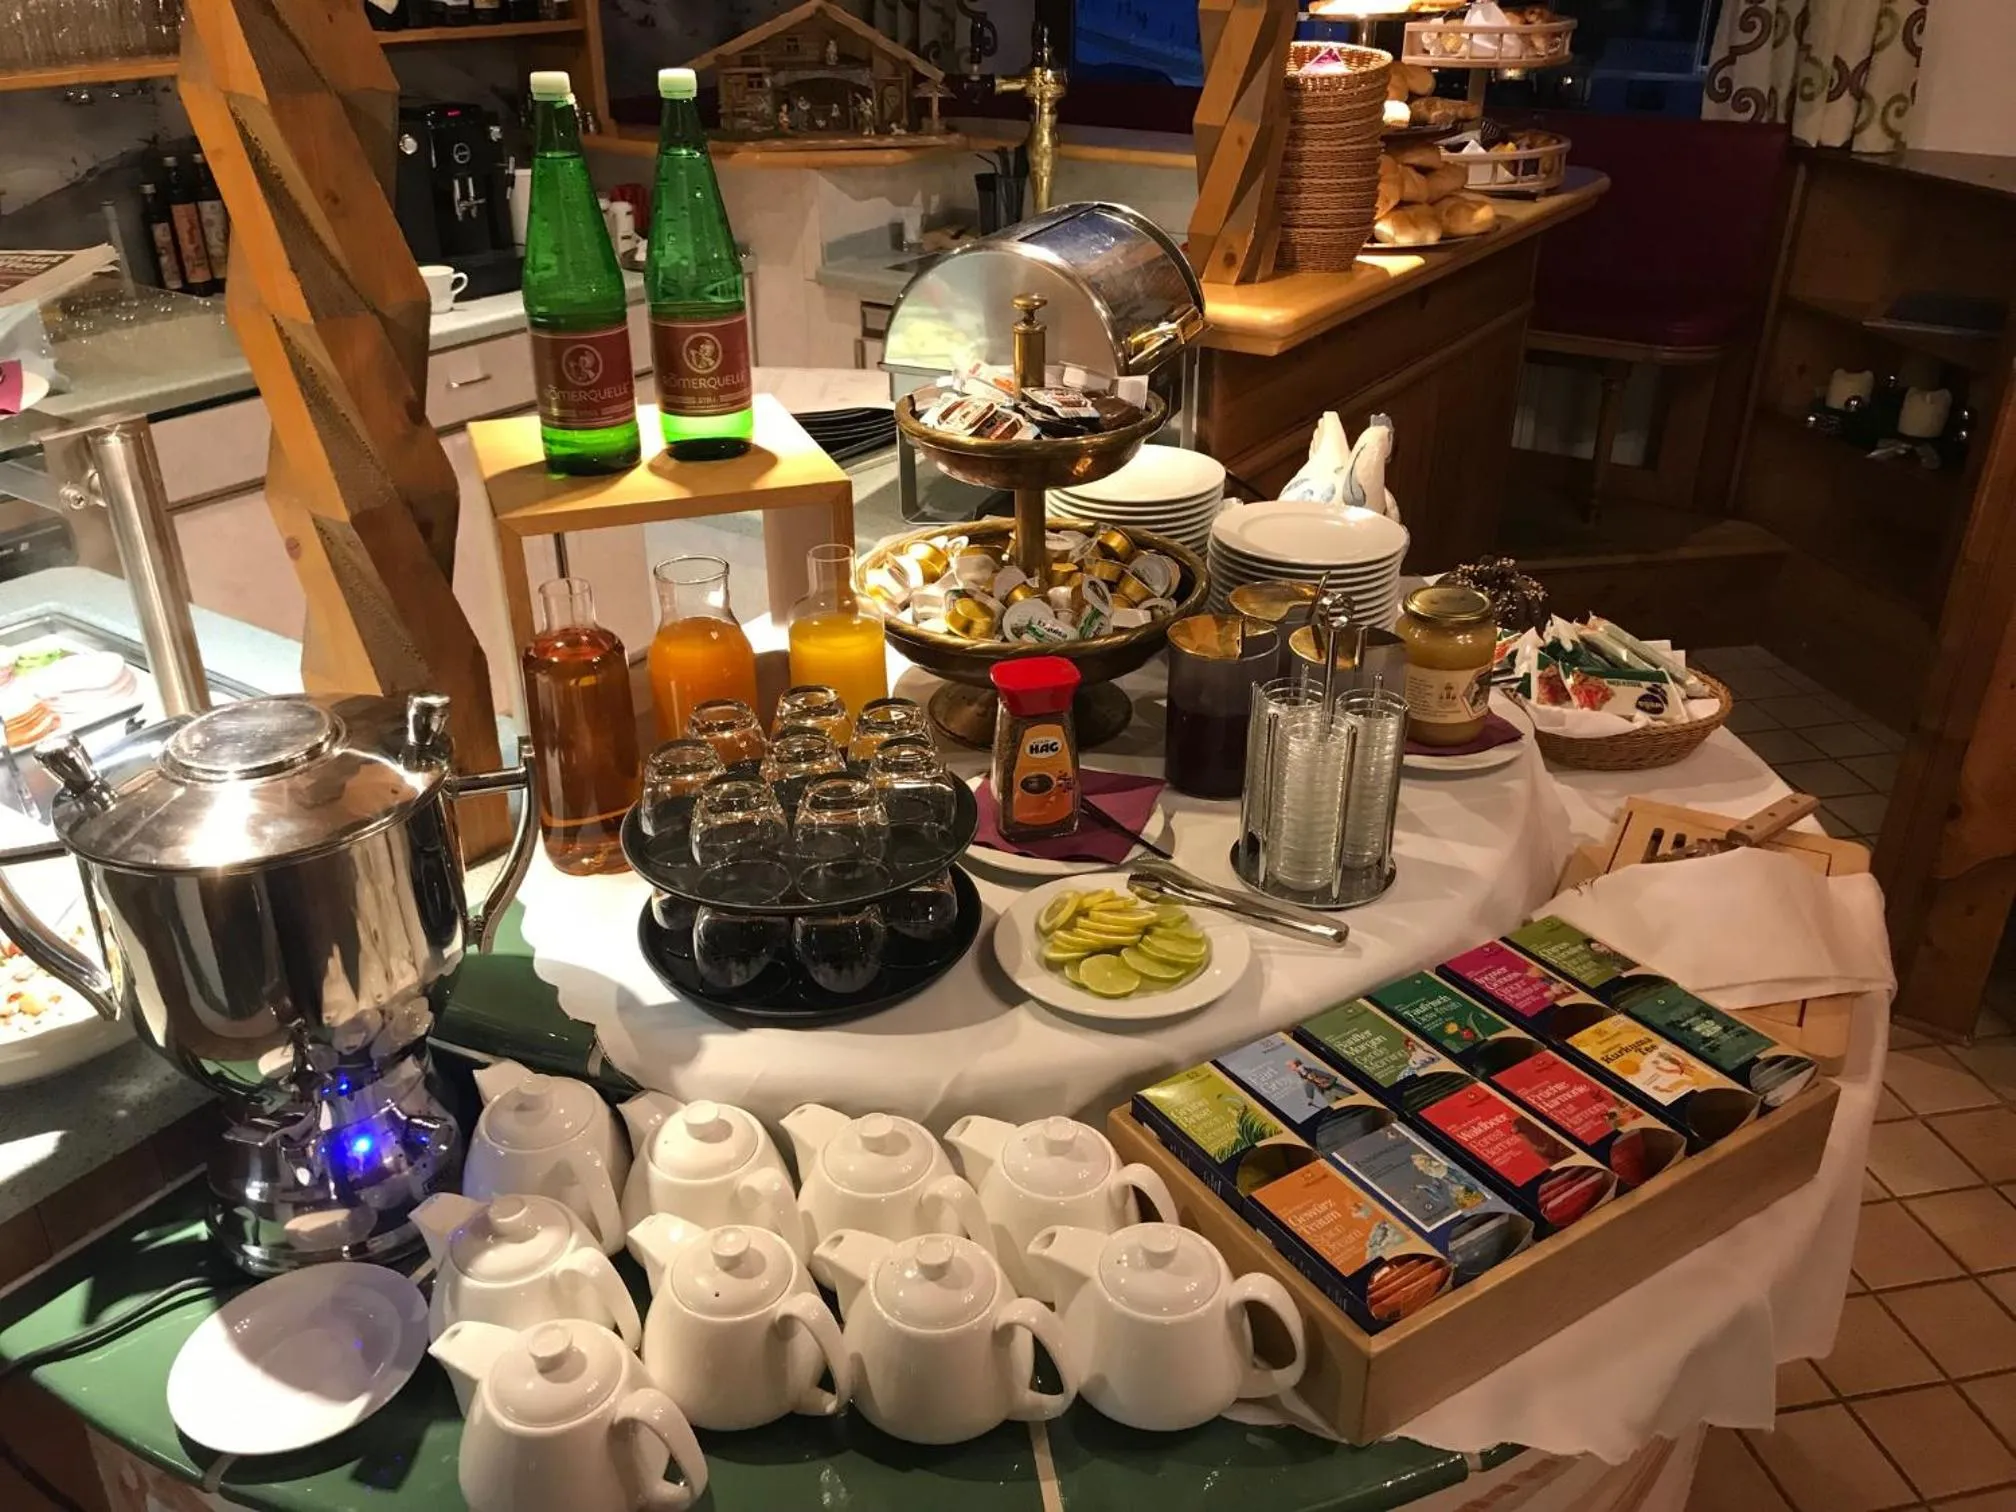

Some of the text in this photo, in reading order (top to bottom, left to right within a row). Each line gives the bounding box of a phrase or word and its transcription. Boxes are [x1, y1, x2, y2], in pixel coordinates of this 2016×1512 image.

[1029, 741, 1059, 755] HAG
[1600, 1036, 1653, 1064] Kurkuma
[1634, 1043, 1659, 1056] Tee
[1286, 1198, 1336, 1226] Gewürz
